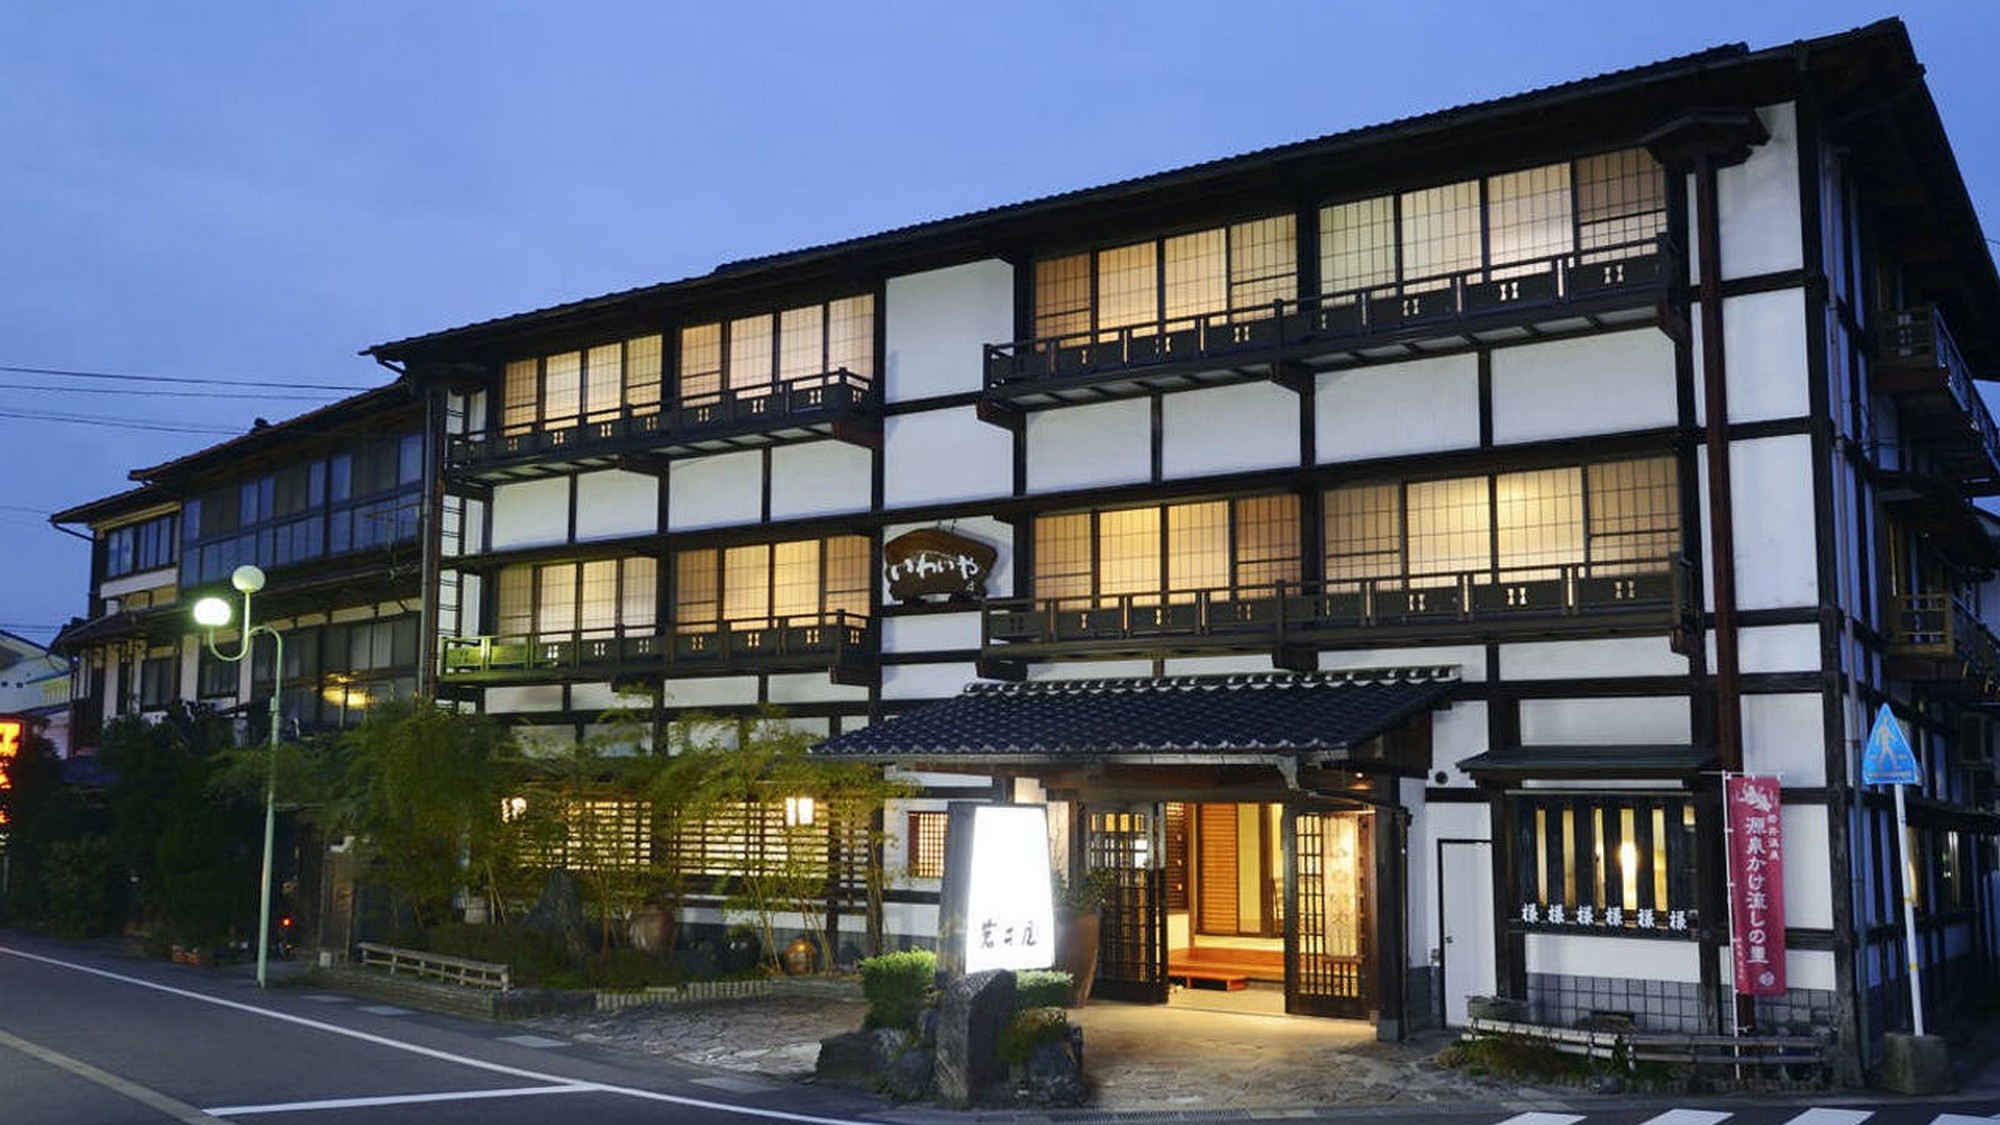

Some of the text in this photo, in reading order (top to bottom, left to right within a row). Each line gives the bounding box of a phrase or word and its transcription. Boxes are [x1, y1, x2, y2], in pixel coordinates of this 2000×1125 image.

[890, 553, 979, 580] いわいや
[1745, 816, 1769, 964] 源泉かけ流しの里
